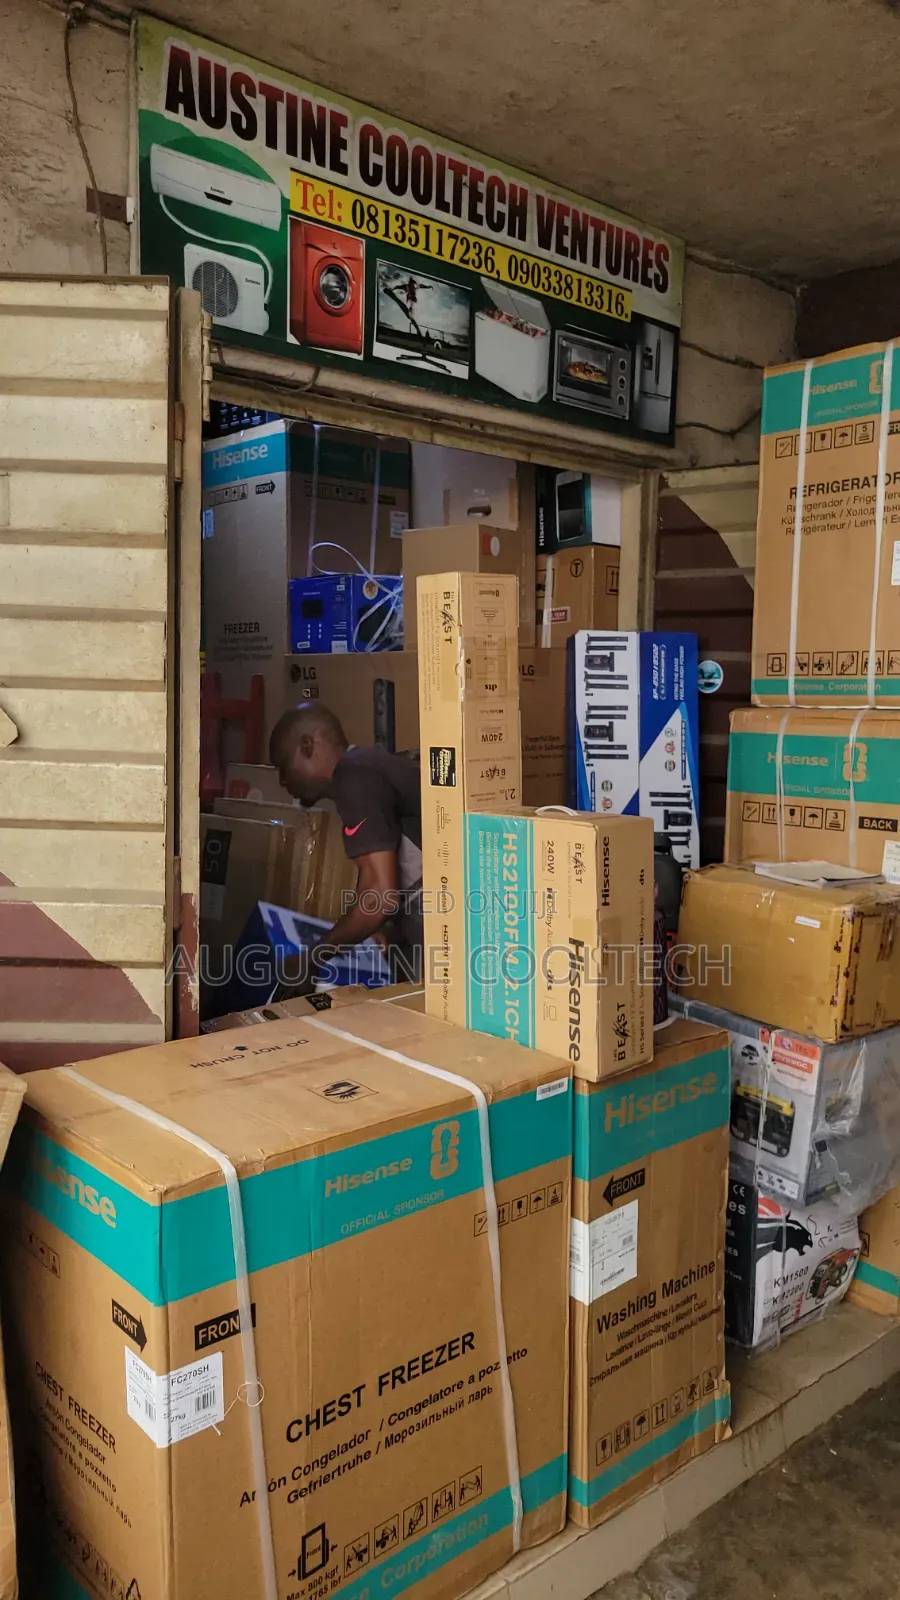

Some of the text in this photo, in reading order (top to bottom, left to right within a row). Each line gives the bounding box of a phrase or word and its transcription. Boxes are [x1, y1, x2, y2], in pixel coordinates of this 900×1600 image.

[164, 44, 670, 294] AUSTINE COOLTECH VENTURES
[296, 179, 630, 320] Tel: 08135117236, 09033813316.
[212, 443, 268, 470] Hisense
[255, 484, 272, 494] FRONT
[223, 622, 260, 635] FREEZER
[303, 667, 316, 680] LG
[522, 664, 534, 676] LG
[481, 732, 503, 742] 240W
[767, 752, 828, 767] Hsense
[863, 819, 892, 830] BACK
[546, 839, 555, 874] 240W
[602, 836, 610, 907] Hisense
[568, 937, 585, 1062] Hisense
[190, 1038, 310, 1069] DO NOT CRUSH
[604, 1071, 718, 1133] Hisense
[324, 1157, 413, 1198] Hisense
[610, 1170, 643, 1199] FRONT
[340, 1188, 444, 1235] OFFICIAL SPONSOR
[597, 1260, 716, 1334] Washing Machine
[112, 1305, 138, 1337] FRONT
[198, 1318, 242, 1346] FRON
[171, 1363, 209, 1386] FC270SH
[286, 1384, 367, 1443] CHEST
[377, 1331, 476, 1397] FREEZER
[34, 1361, 65, 1402] CHEST
[68, 1395, 117, 1454] FREEZER
[239, 1475, 287, 1508] Arón
[291, 1428, 372, 1482] Congelador
[387, 1378, 465, 1427] Congelatore
[467, 1374, 476, 1385] a
[478, 1347, 529, 1385] pozetto
[384, 1383, 493, 1449] Морозильный ларь
[64, 1419, 107, 1465] Congelador
[286, 1449, 372, 1505] Gefriertruhe
[381, 1513, 488, 1588] Corporation
